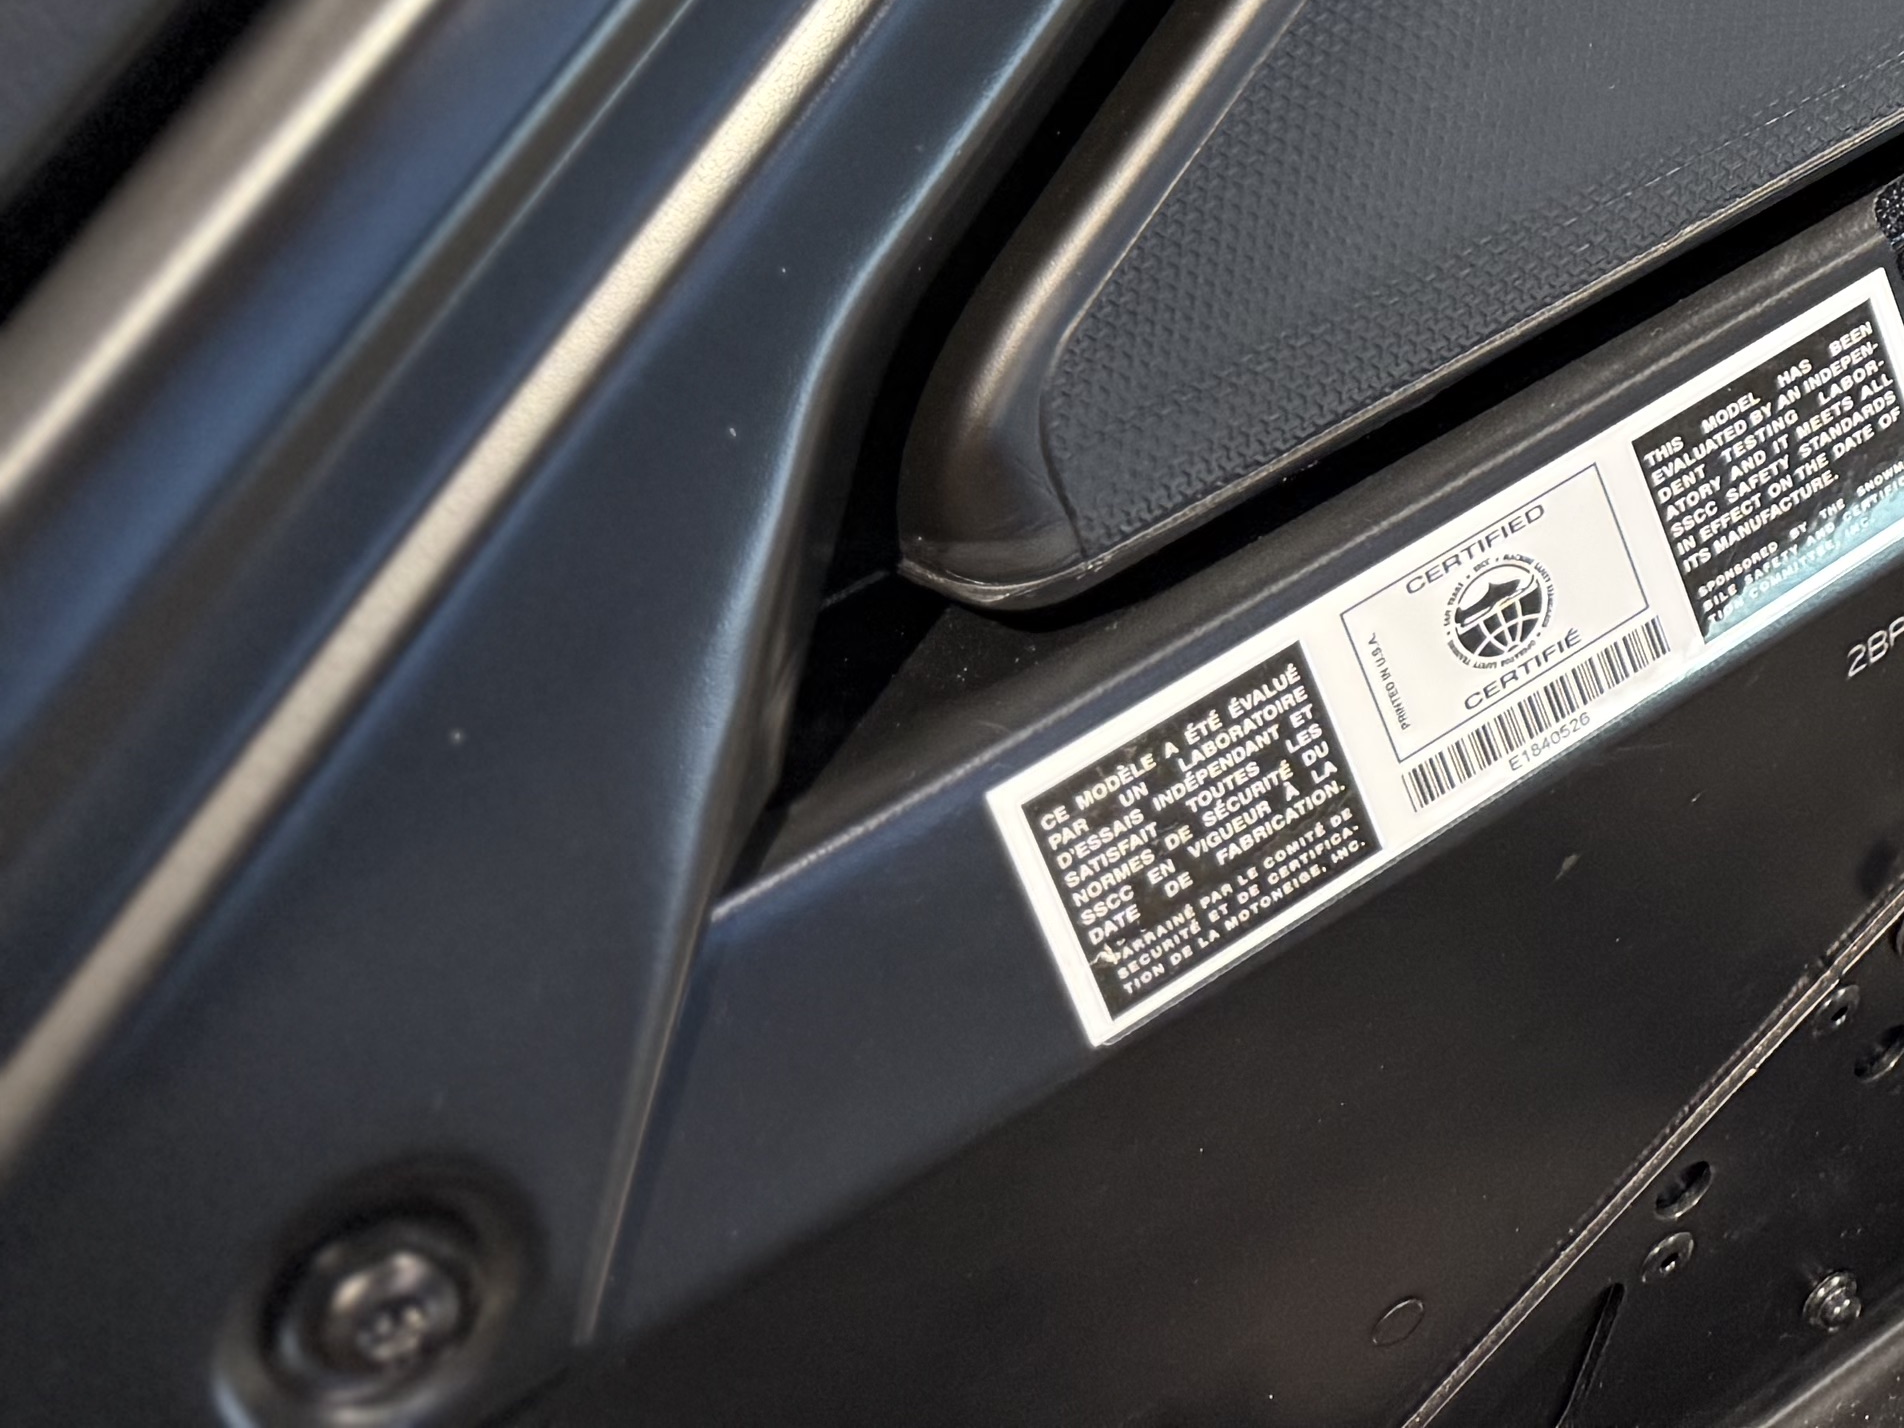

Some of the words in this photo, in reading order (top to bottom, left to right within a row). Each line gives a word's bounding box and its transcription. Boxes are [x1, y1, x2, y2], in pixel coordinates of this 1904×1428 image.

[1642, 435, 1684, 467] THIS
[1700, 391, 1761, 434] MODEL
[1775, 357, 1812, 389] HAS
[1827, 320, 1873, 357] BEEN
[1650, 418, 1747, 487] EVALUATED
[1747, 400, 1772, 427] BY
[1776, 384, 1802, 411] AN
[1801, 340, 1879, 394] INDEPEN-
[1656, 462, 1705, 504] DENT
[1719, 408, 1799, 463] TESTING
[1816, 358, 1885, 407] LABOR-
[1664, 474, 1721, 522] ATORY
[1729, 448, 1767, 482] AND
[1771, 432, 1789, 455] IT
[1794, 394, 1854, 440] MEETS
[1859, 372, 1894, 402] ALL
[1404, 503, 1545, 594] CERTIFIED
[1379, 666, 1393, 683] IN
[1384, 679, 1412, 731] PRINTED
[1463, 626, 1581, 710] CERTIFIÉ
[1507, 710, 1591, 772] E1840526
[1039, 804, 1071, 831] CE
[1073, 752, 1157, 811] MODÈLE
[1163, 740, 1180, 759] A
[1182, 708, 1223, 746] ÉTÉ
[1226, 661, 1301, 719] ÉVALUÉ
[1047, 817, 1090, 851] PAR
[1117, 780, 1149, 808] UN
[1176, 684, 1308, 773] LABORATOIRE
[1055, 807, 1144, 870] D'ESSAIS
[1151, 722, 1279, 812] INDÉPENDANT
[1288, 702, 1313, 729] ET
